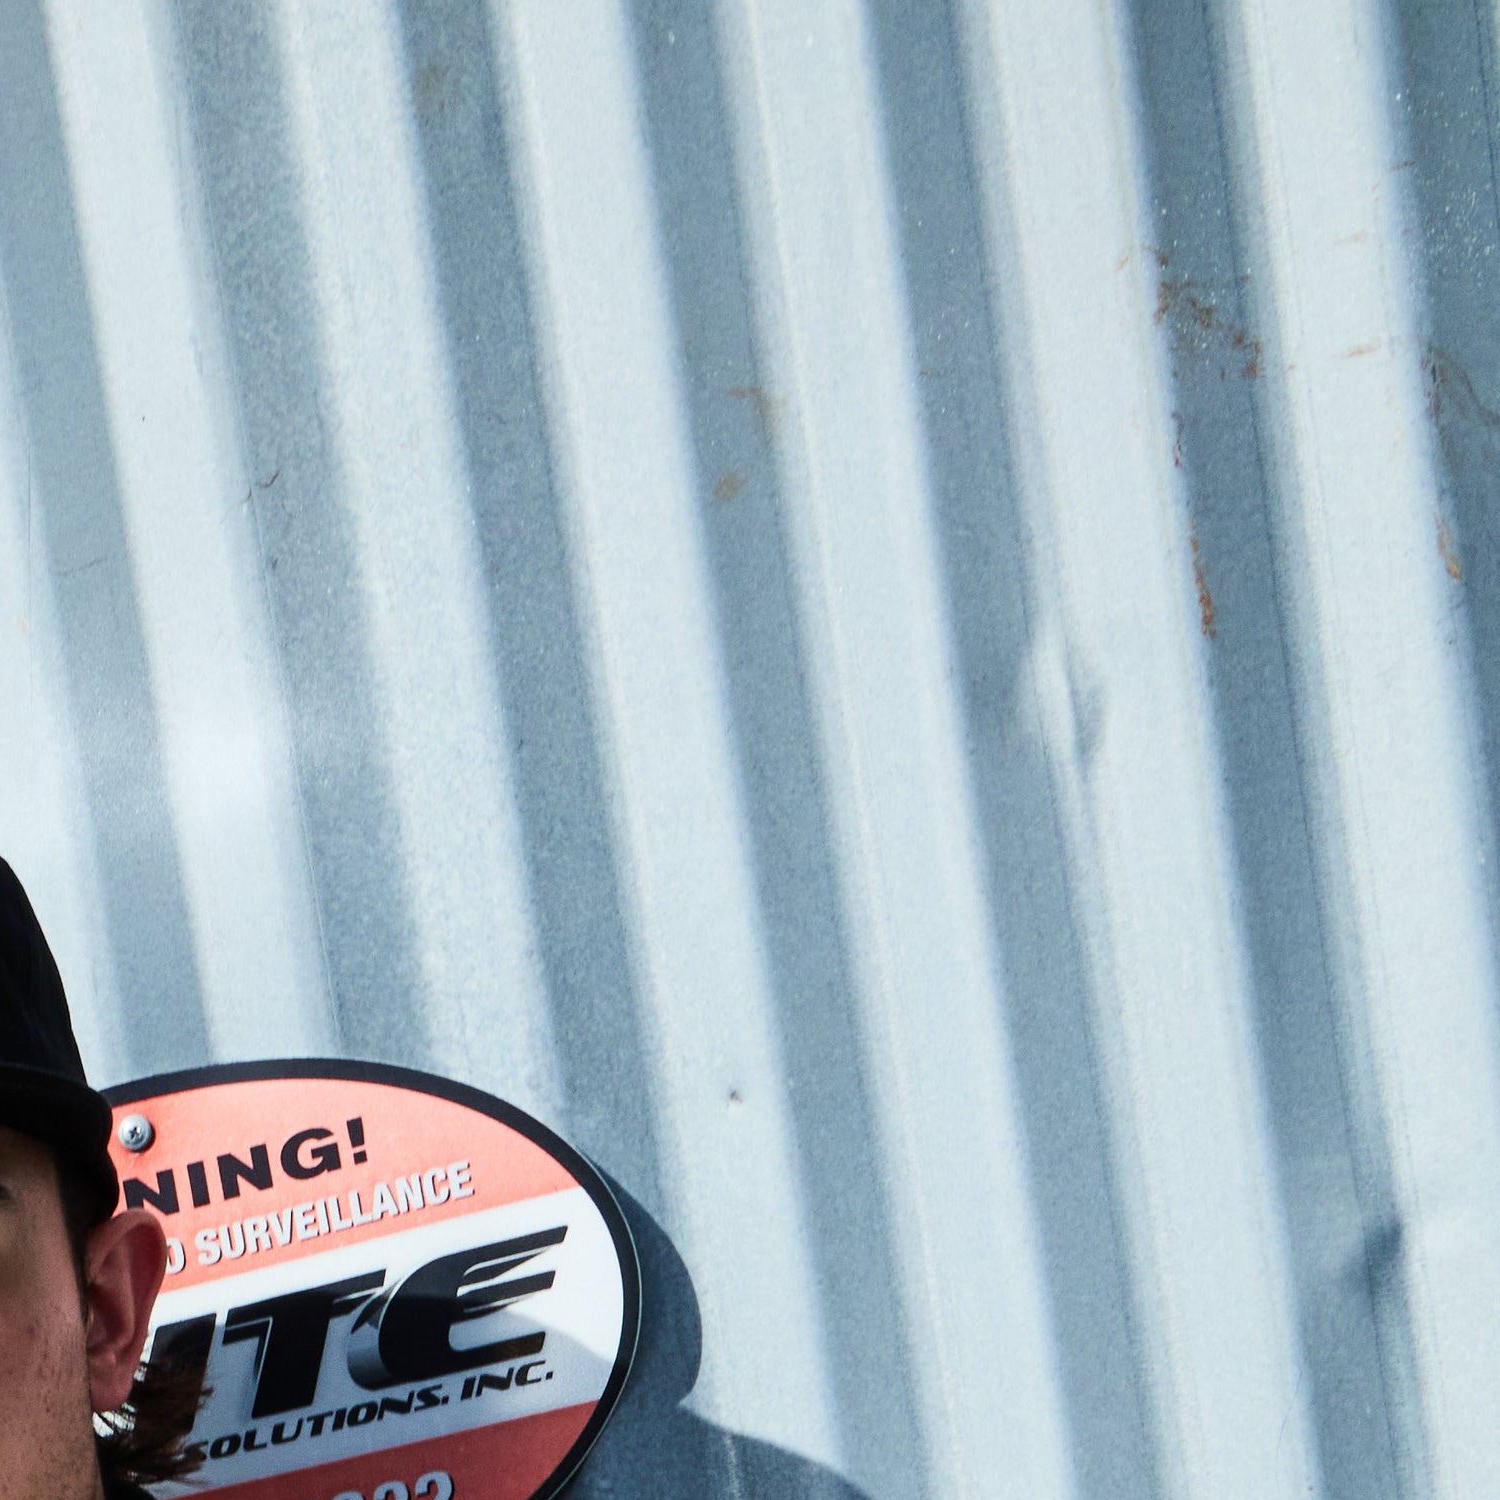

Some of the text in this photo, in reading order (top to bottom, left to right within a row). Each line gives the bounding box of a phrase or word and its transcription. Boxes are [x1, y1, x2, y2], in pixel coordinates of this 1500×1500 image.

[123, 1117, 368, 1216] NING!
[196, 1163, 475, 1266] SURVEILLANCE
[140, 1225, 570, 1440] ITE
[460, 1359, 554, 1401] INC.
